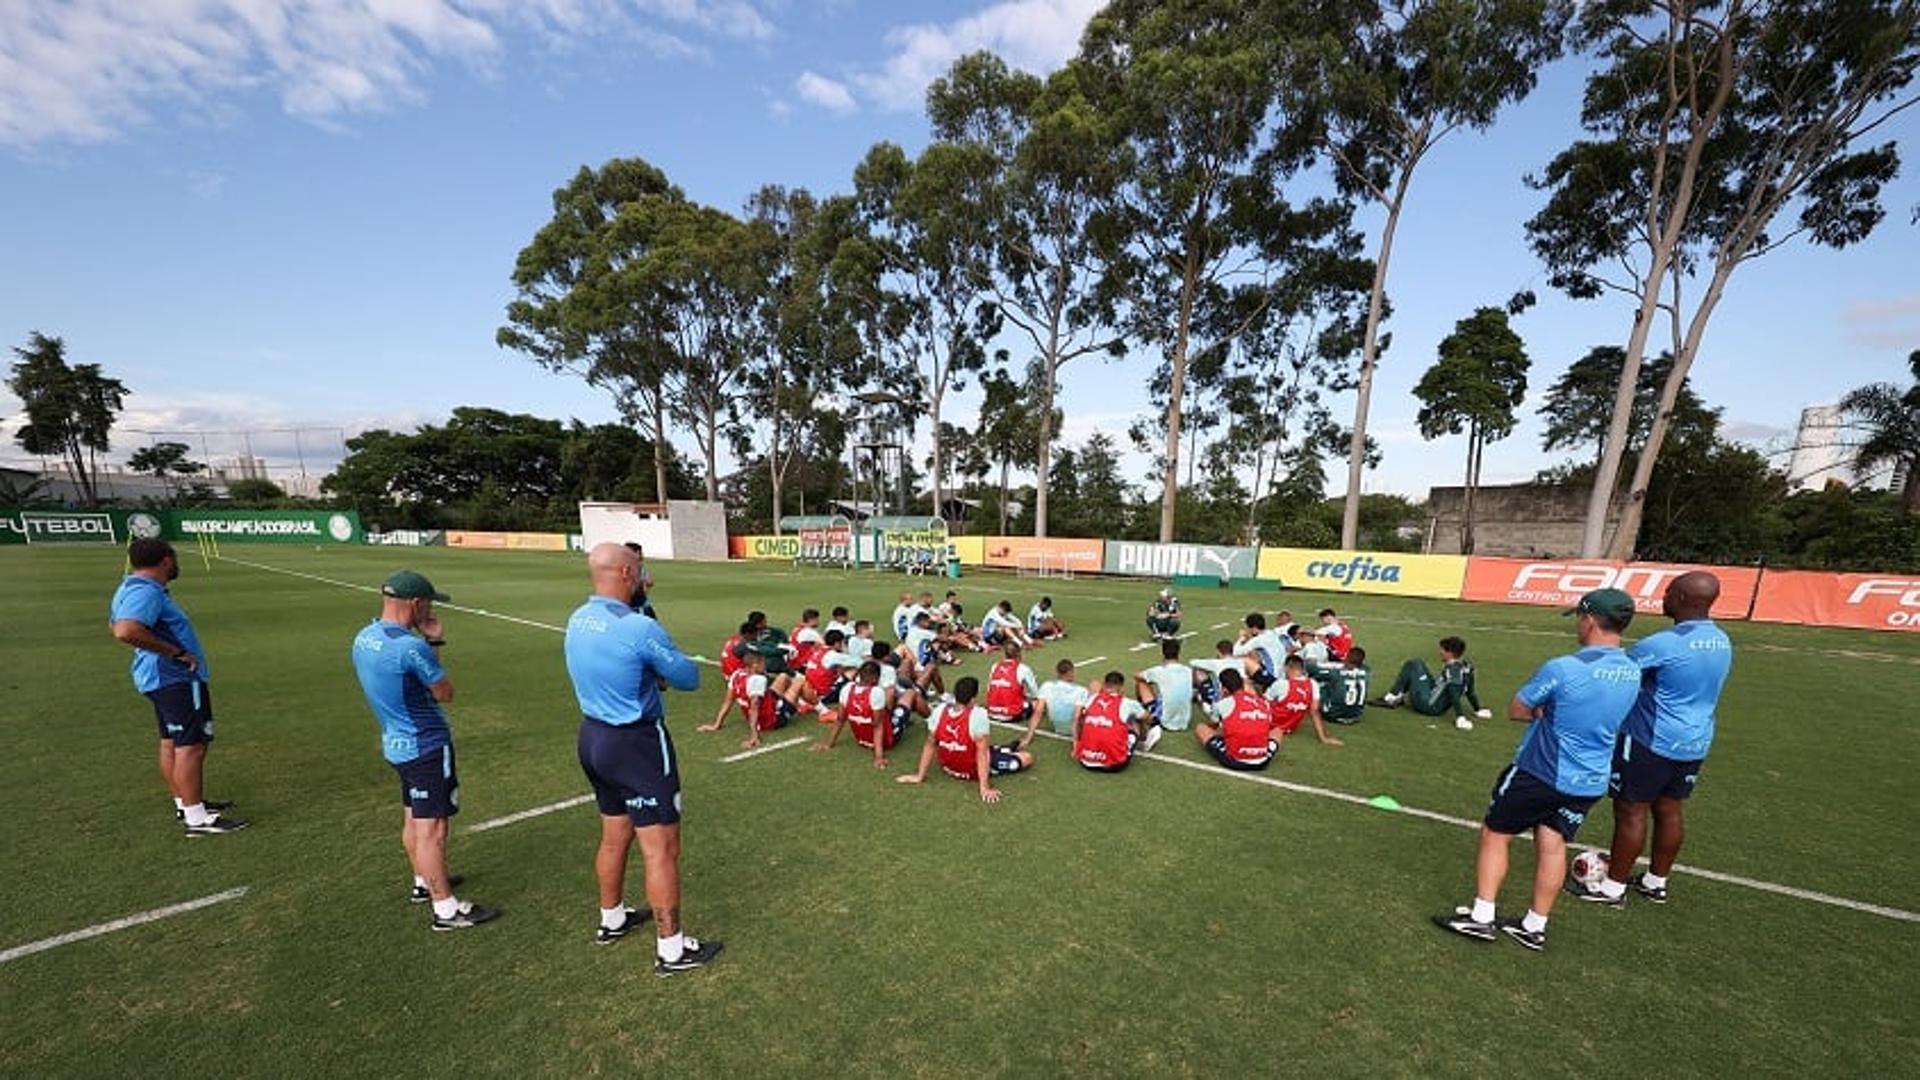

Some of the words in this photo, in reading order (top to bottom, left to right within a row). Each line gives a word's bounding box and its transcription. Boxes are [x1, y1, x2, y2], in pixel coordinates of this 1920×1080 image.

[755, 538, 799, 556] CIMED
[1119, 545, 1197, 574] PUMA
[1306, 557, 1401, 586] crefisa
[1507, 590, 1561, 601] CENTRO
[1344, 679, 1366, 706] 31
